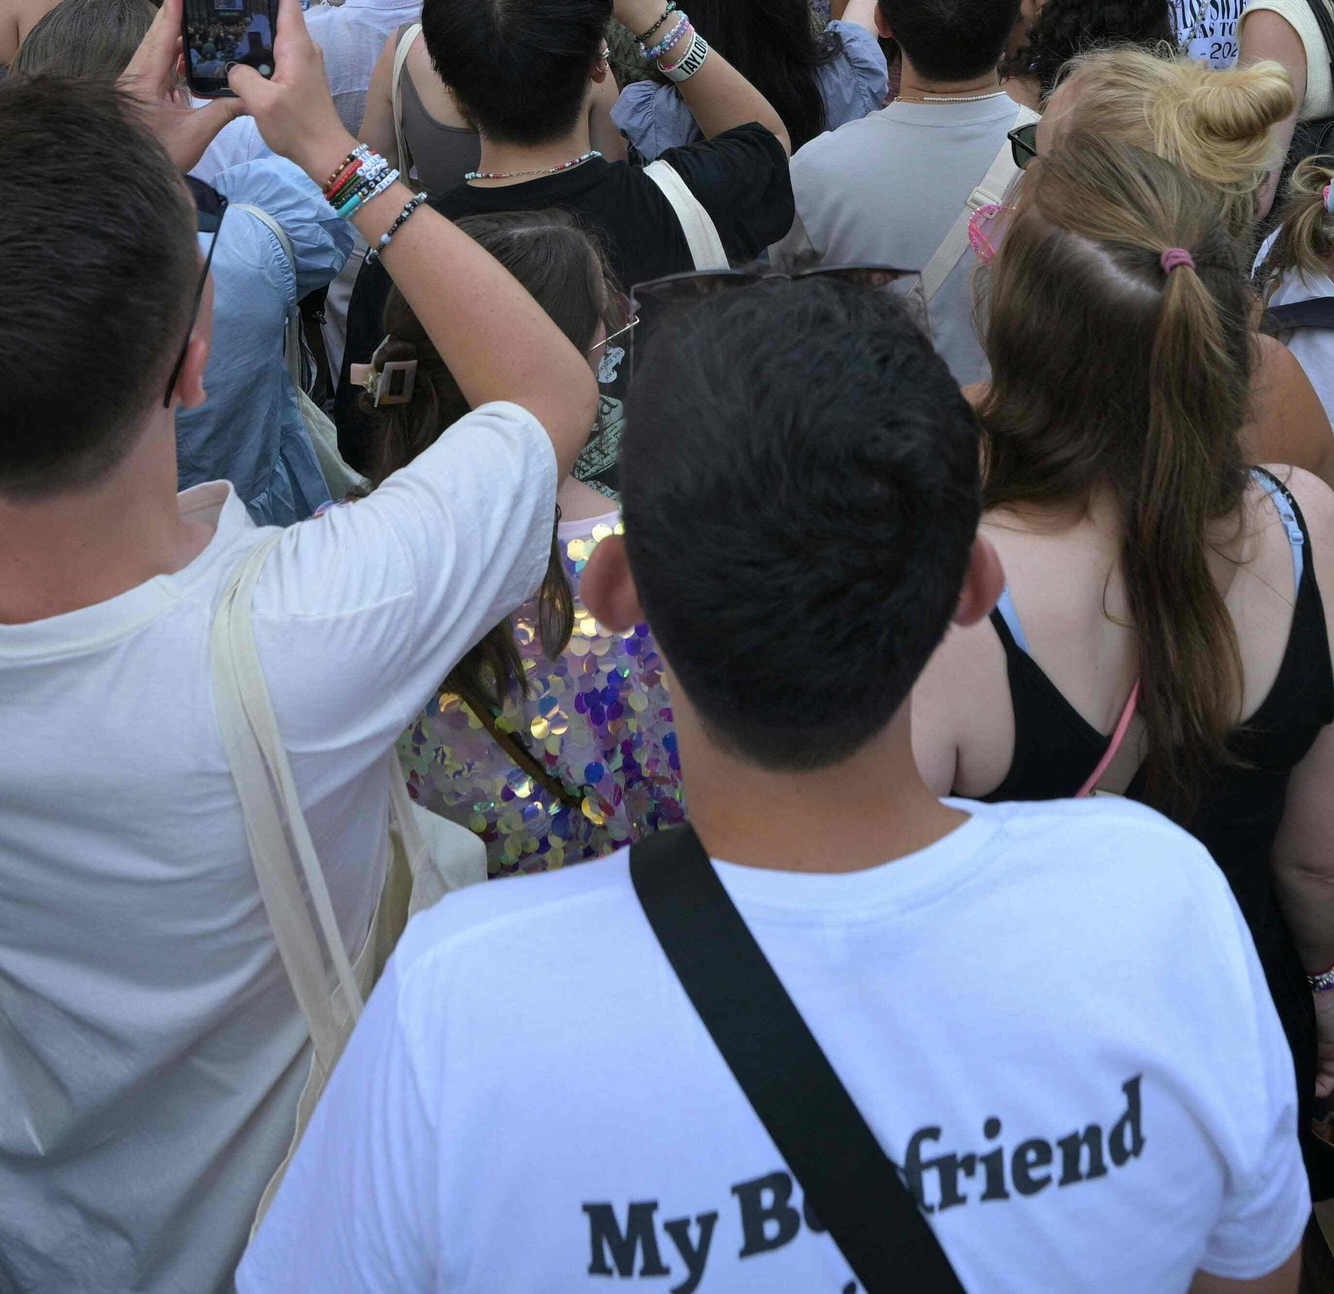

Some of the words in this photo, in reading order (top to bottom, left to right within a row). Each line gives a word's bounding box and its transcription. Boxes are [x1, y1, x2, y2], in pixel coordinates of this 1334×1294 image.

[678, 34, 708, 76] TAYLOR
[581, 1199, 718, 1294] My
[731, 1073, 1148, 1259] Bfriend
